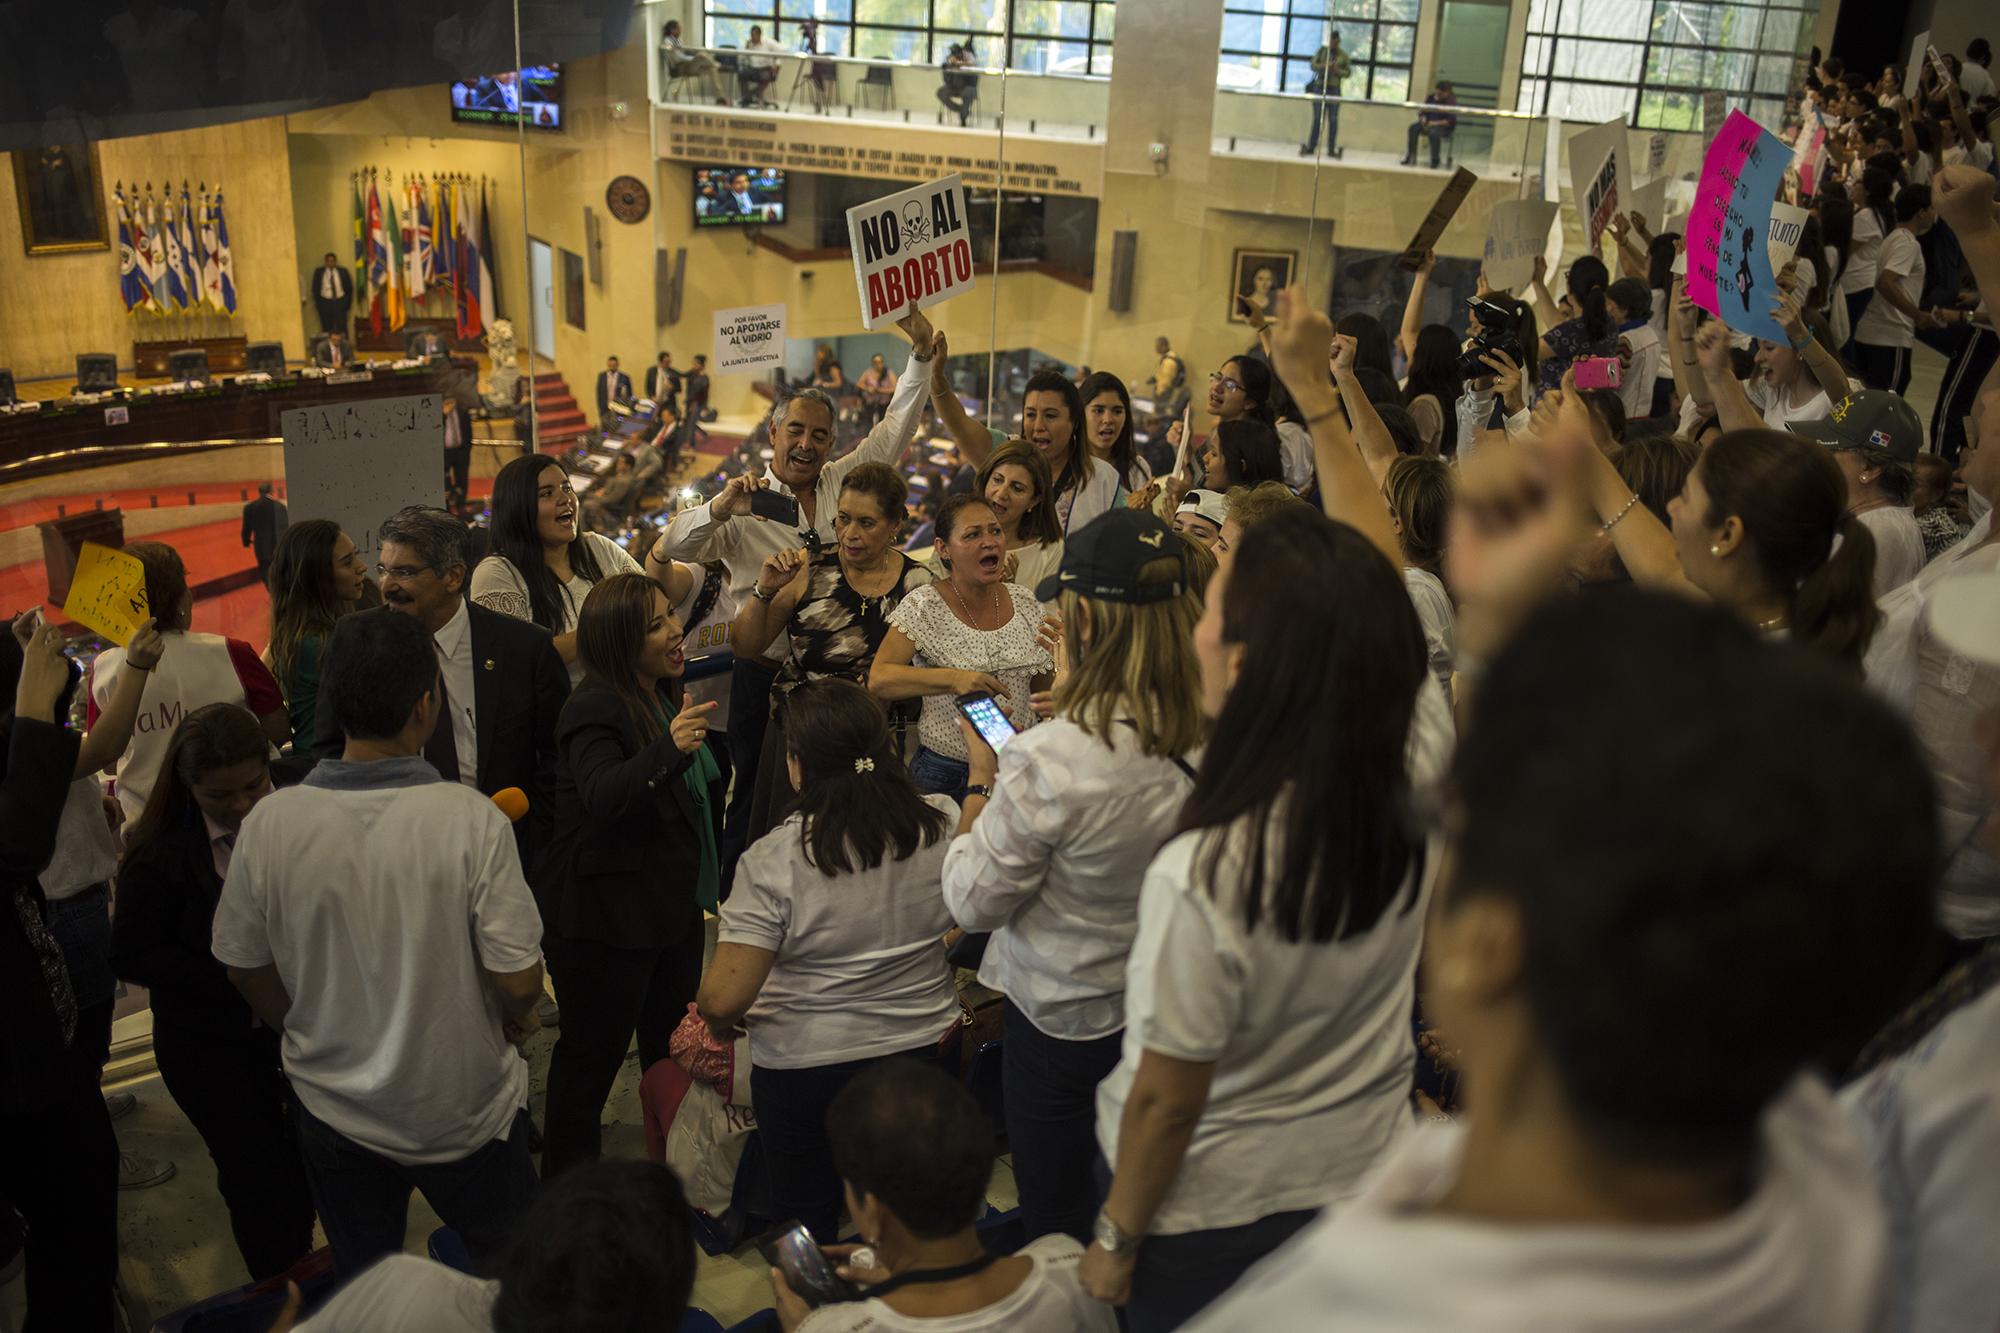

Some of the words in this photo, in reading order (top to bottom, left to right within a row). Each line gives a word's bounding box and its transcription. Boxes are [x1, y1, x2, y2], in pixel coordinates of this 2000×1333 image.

[861, 210, 900, 264] NO
[931, 189, 961, 238] AL
[1723, 249, 1732, 266] DE
[868, 239, 971, 319] ABORTO
[735, 316, 746, 324] POR
[748, 314, 767, 322] FAVOR
[720, 326, 734, 336] NO
[737, 320, 781, 334] APOYARSE
[730, 336, 741, 345] AL
[742, 332, 772, 343] VIDRIO
[731, 358, 748, 366] JUNTA
[750, 354, 779, 363] DIRECTIVA
[135, 701, 187, 734] aM
